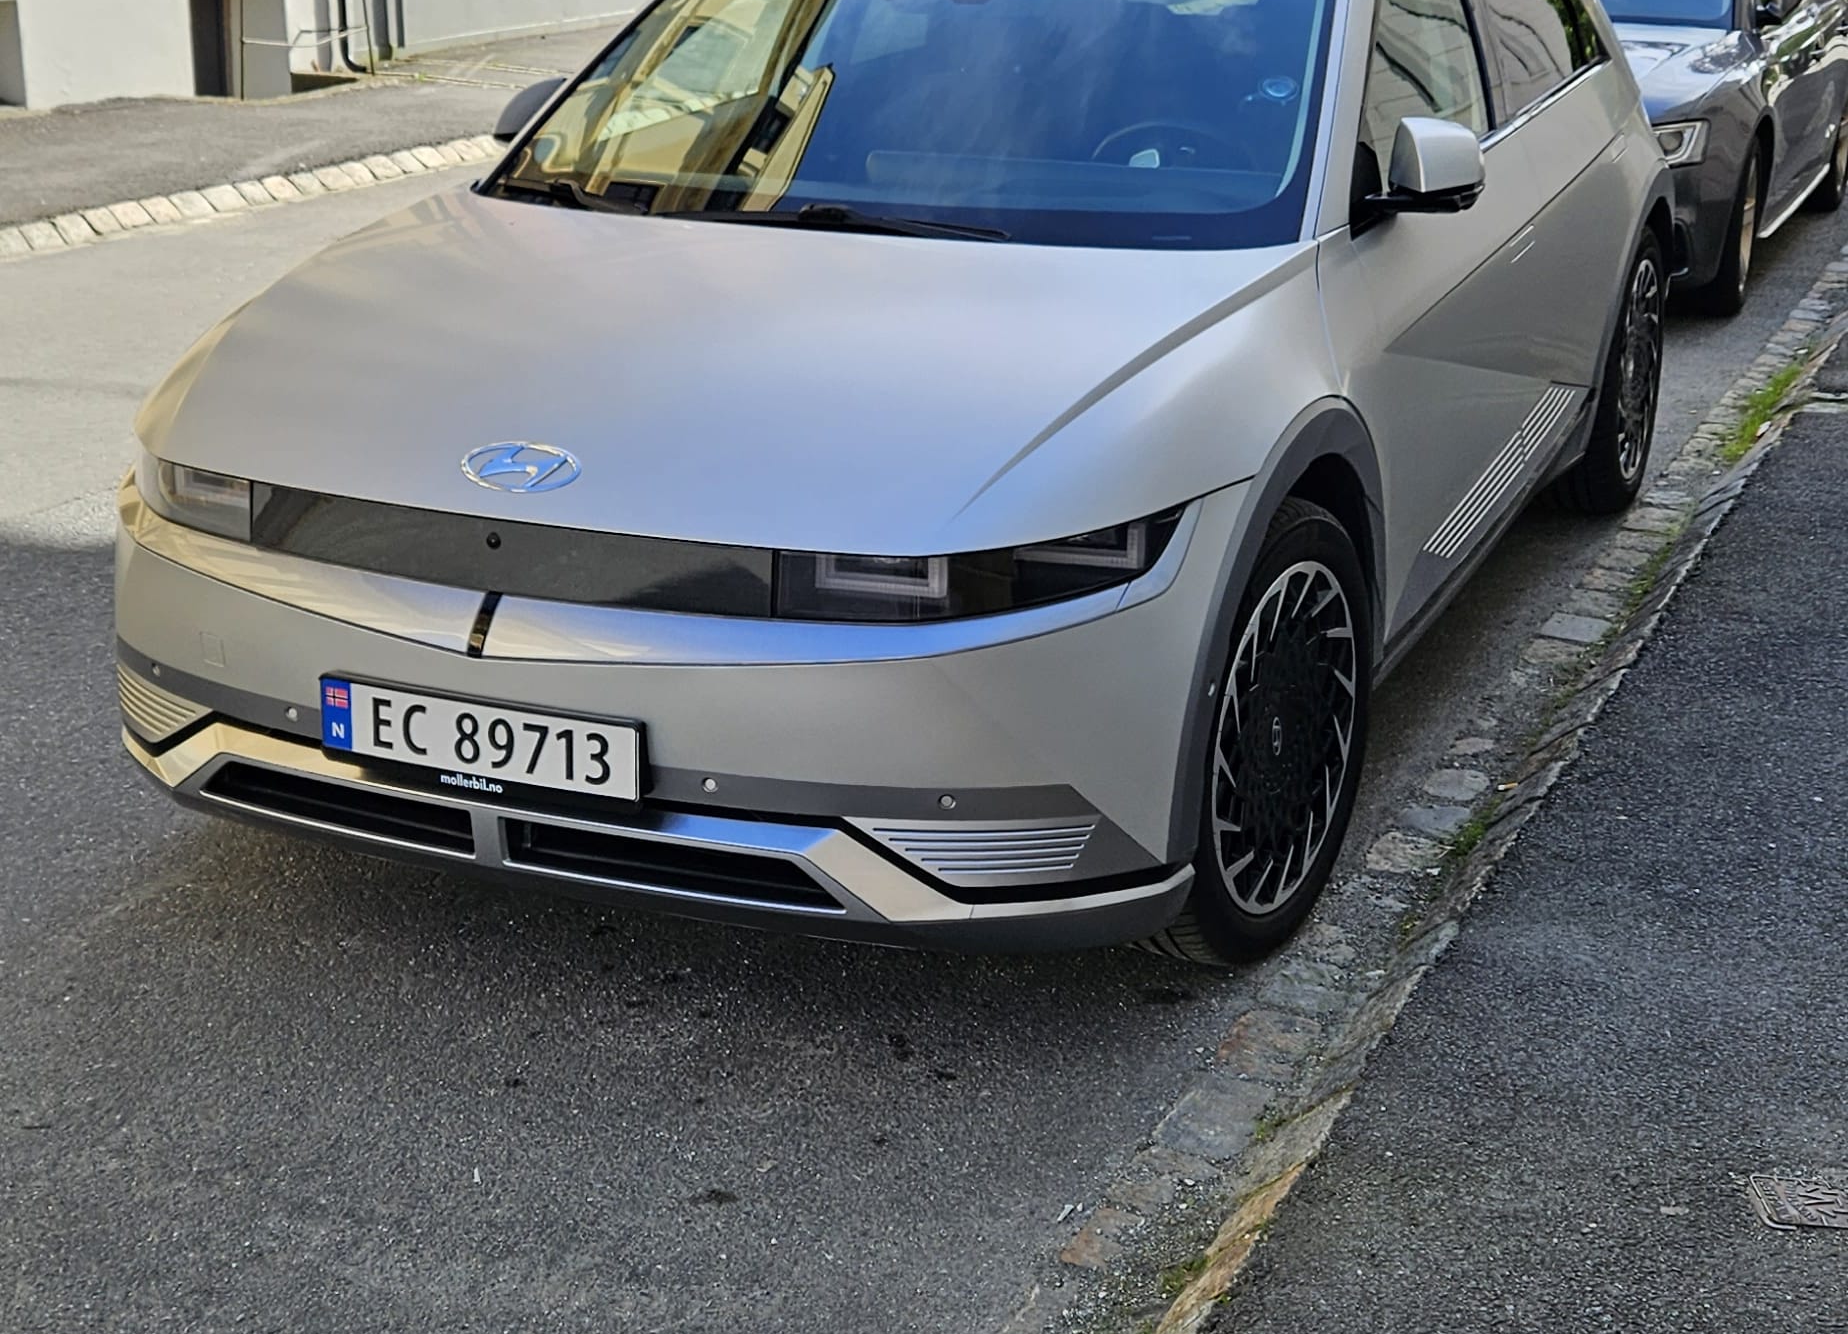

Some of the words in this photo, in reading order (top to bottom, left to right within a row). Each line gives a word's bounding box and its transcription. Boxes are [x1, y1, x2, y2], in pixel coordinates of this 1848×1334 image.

[331, 722, 345, 739] N
[372, 696, 428, 755] EC
[454, 712, 611, 786] 89713
[440, 773, 504, 794] mollerbil.no
